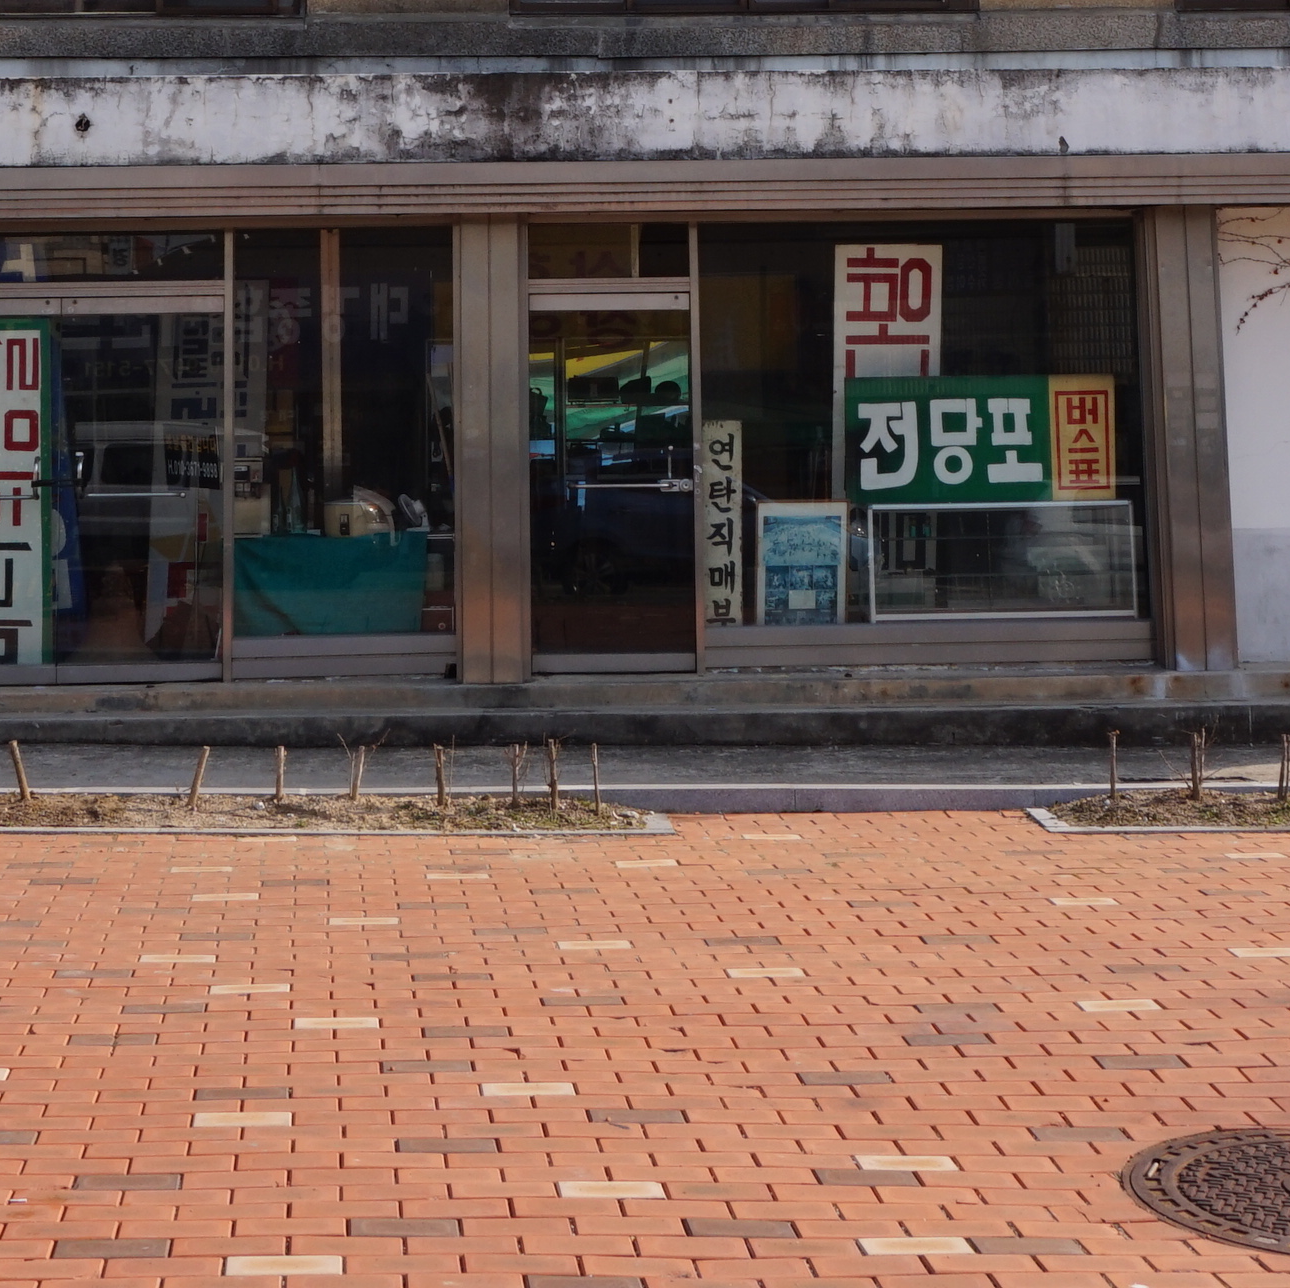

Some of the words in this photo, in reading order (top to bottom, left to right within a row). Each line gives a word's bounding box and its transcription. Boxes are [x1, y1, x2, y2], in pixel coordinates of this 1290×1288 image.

[858, 398, 1044, 491] 전당포
[1066, 396, 1100, 484] 버스표
[706, 433, 737, 626] 연탄직매부
